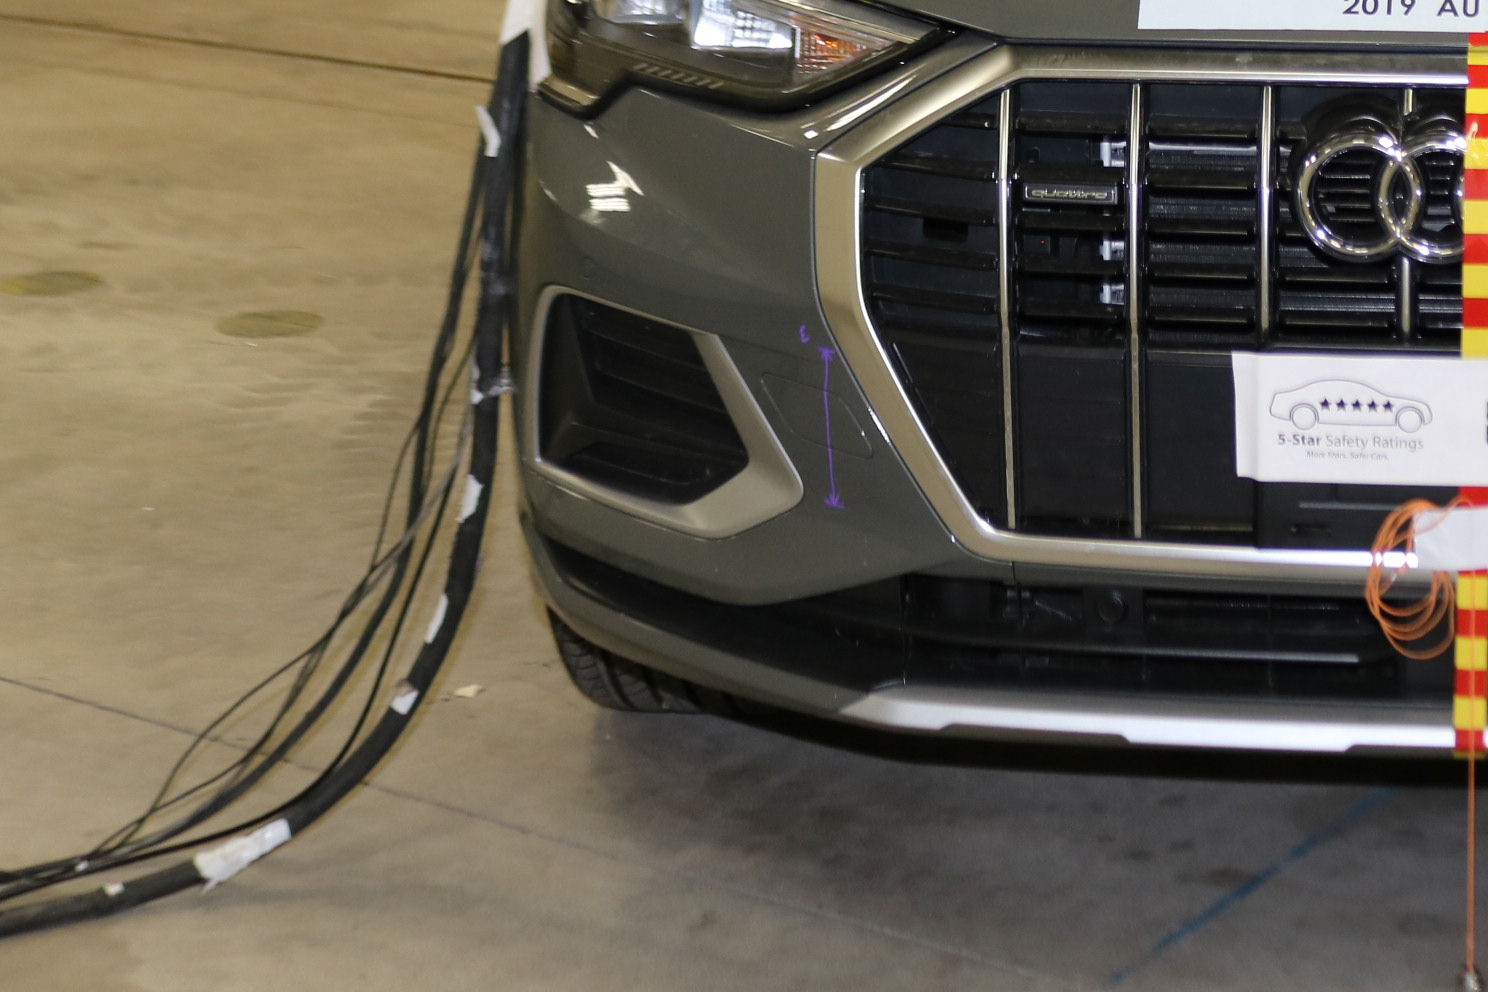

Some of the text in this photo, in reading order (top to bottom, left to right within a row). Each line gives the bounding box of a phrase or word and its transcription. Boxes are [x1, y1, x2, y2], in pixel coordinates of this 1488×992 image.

[1031, 188, 1108, 199] quattro
[1277, 434, 1425, 453] 5-Star Safety Ratings
